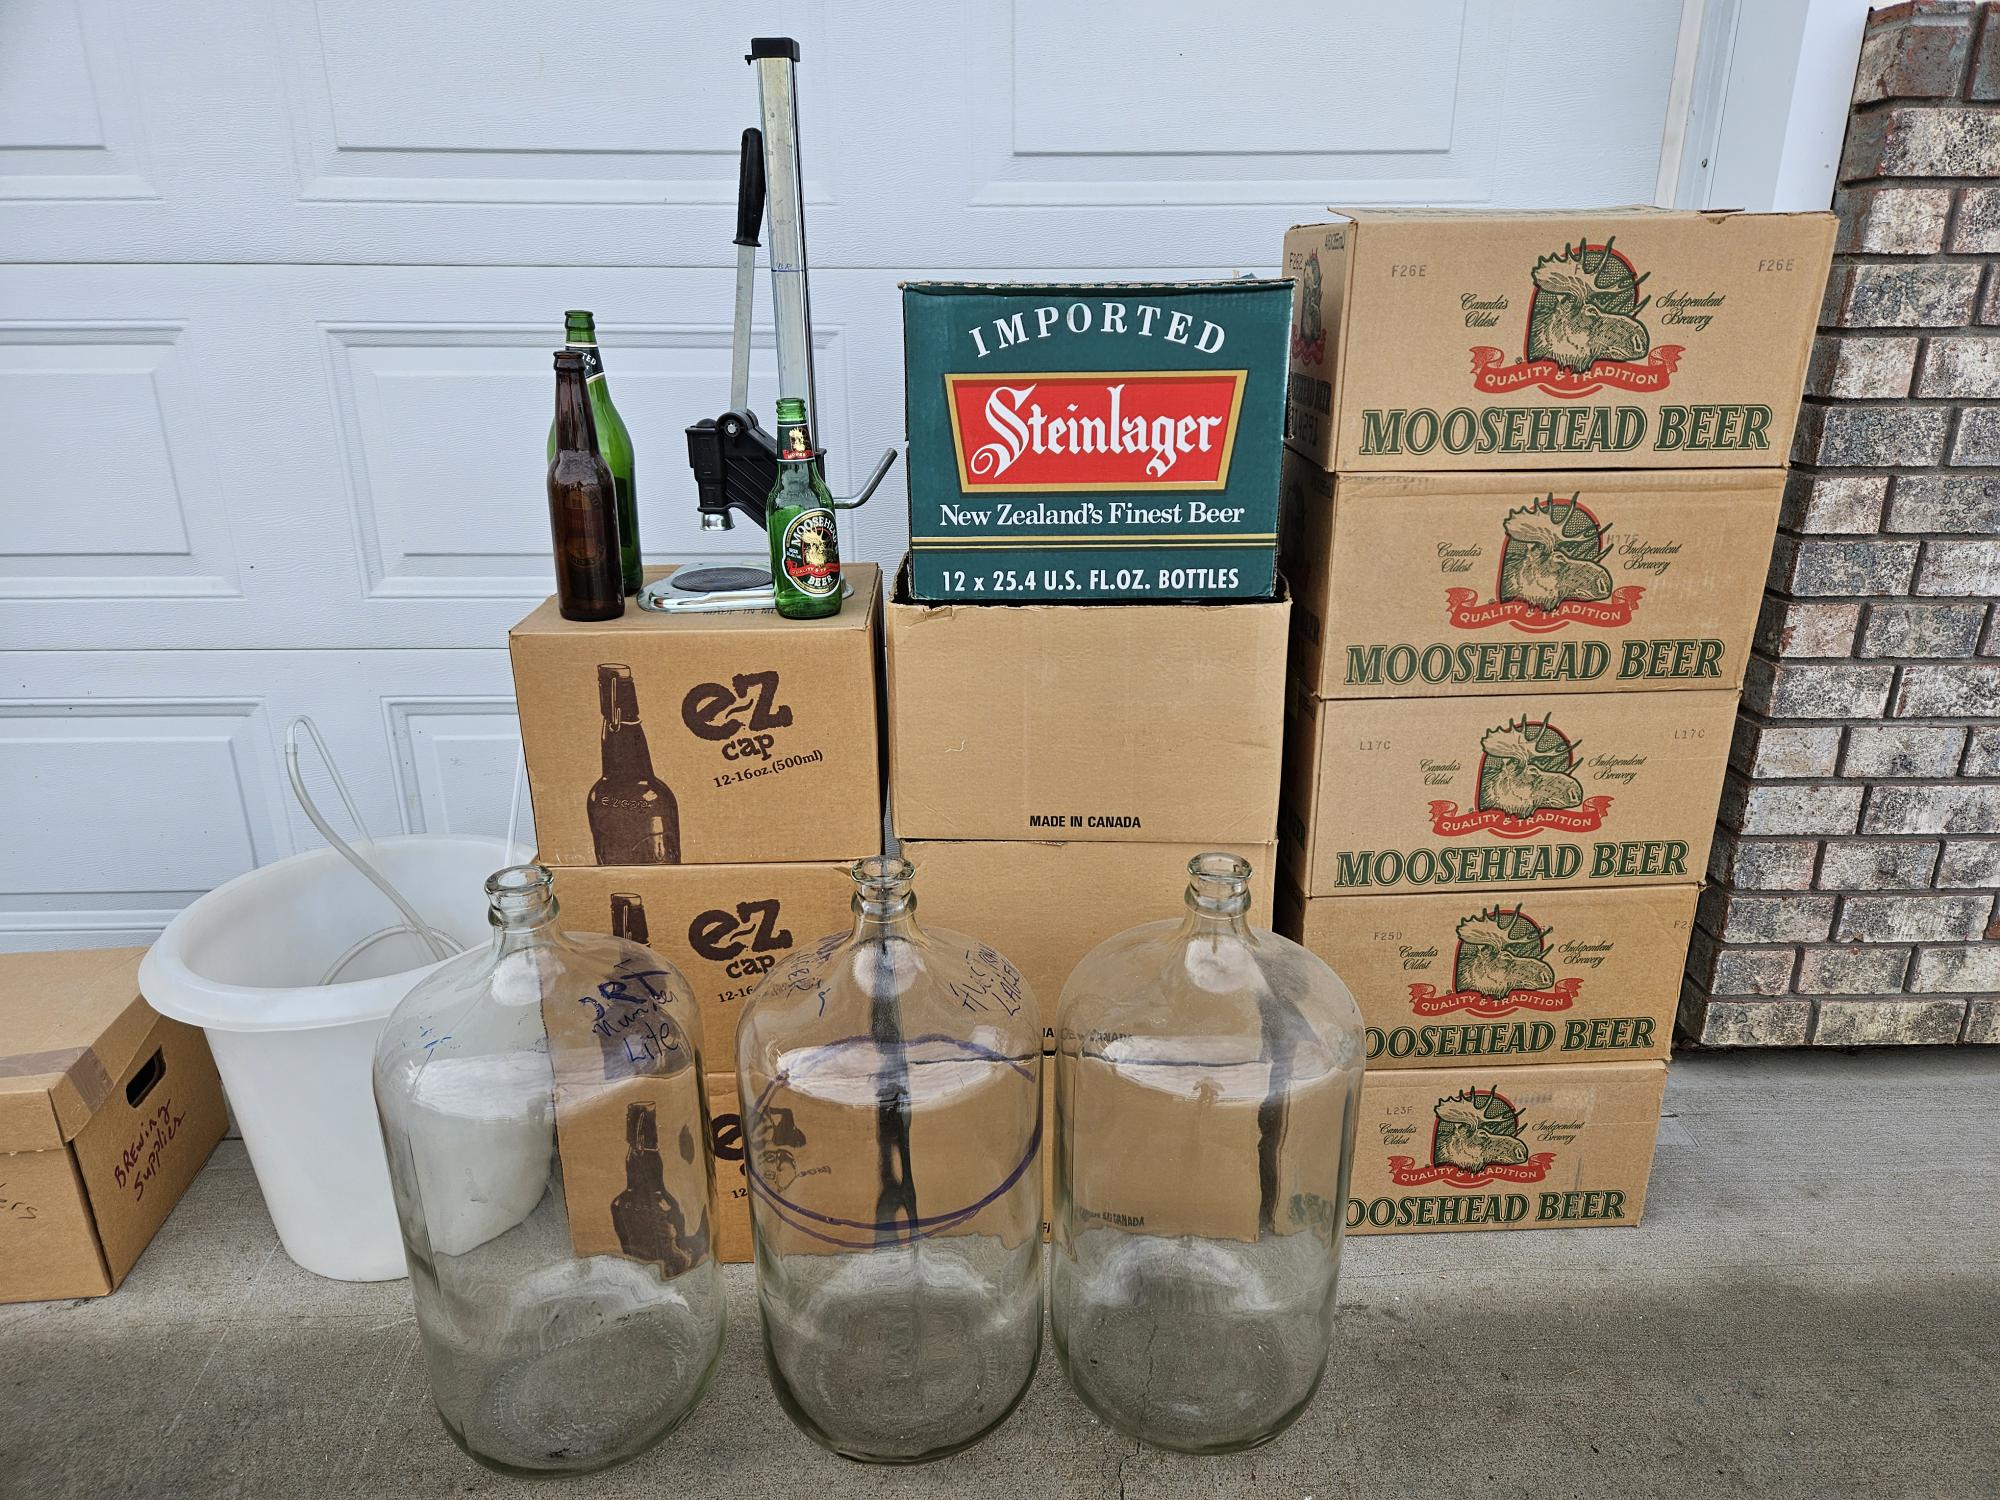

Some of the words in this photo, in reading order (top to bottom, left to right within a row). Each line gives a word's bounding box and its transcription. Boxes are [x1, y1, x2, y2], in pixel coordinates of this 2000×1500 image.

[1391, 264, 1427, 277] F26E
[1759, 258, 1795, 272] F26E
[1460, 293, 1509, 311] Canada's
[1656, 289, 1727, 311] Independent
[1464, 311, 1500, 328] Oldest
[1661, 307, 1714, 331] Brewery
[968, 302, 1226, 358] IMPORTED
[1485, 366, 1553, 386] QUALITY
[1555, 371, 1565, 382] &
[1570, 365, 1659, 385] TRADITION
[970, 383, 1223, 479] Steinlager
[1359, 406, 1648, 456] MOOSEHEAD
[1653, 403, 1773, 453] BEER
[940, 503, 990, 526] New
[997, 502, 1103, 526] Zealand's
[1108, 502, 1183, 525] Finest
[1188, 502, 1245, 524] Beer
[1437, 542, 1482, 558] Canada's
[1618, 540, 1683, 556] Independent
[1441, 558, 1472, 573] Oldest
[1623, 555, 1672, 575] Brewery
[942, 571, 966, 592] 12
[974, 576, 985, 592] x
[993, 570, 1037, 591] 25.4
[1044, 569, 1082, 590] U.S.
[1090, 569, 1151, 590] FL.OZ.
[1158, 568, 1239, 589] BOTTLES
[1459, 605, 1523, 623] QUALITY
[1541, 604, 1621, 621] TRADITION
[1345, 640, 1612, 686] MOOSEHEAD
[1616, 638, 1726, 680] BEER
[721, 733, 775, 761] cap
[713, 749, 824, 788] 12-16oz.(500ml)
[1419, 758, 1462, 774] Canada's
[1588, 752, 1648, 770] Independent
[1424, 773, 1454, 786] Oldest
[1594, 768, 1638, 786] Brewery
[1029, 815, 1066, 827] MADE
[1070, 816, 1083, 827] IN
[1088, 816, 1141, 828] CANADA
[1441, 814, 1500, 832] QUALITY
[1502, 817, 1513, 827] &
[1516, 811, 1592, 828] TRADITION
[1334, 844, 1584, 887] MOOSEHEAD
[1589, 840, 1690, 879] BEER
[1399, 945, 1440, 960] Canada's
[1558, 940, 1614, 956] Independent
[725, 954, 775, 979] cap
[1403, 958, 1431, 971] Oldest
[1563, 952, 1606, 969] Brewery
[1421, 994, 1477, 1012] QUALITY
[1478, 998, 1489, 1007] &
[1493, 993, 1564, 1008] TRADITION
[1364, 1020, 1556, 1061] OOSEHEAD
[1561, 1016, 1657, 1052] BEER
[1386, 1105, 1413, 1115] L23F
[1379, 1122, 1417, 1137] Canada's
[1532, 1117, 1586, 1133] Independent
[1383, 1134, 1411, 1146] Oldest
[1537, 1130, 1578, 1145] Brewery
[1400, 1166, 1453, 1183] QUALITY
[1469, 1165, 1538, 1180] TRADITION
[1346, 1195, 1529, 1229] OOSEHEAD
[1537, 1190, 1627, 1222] BEER
